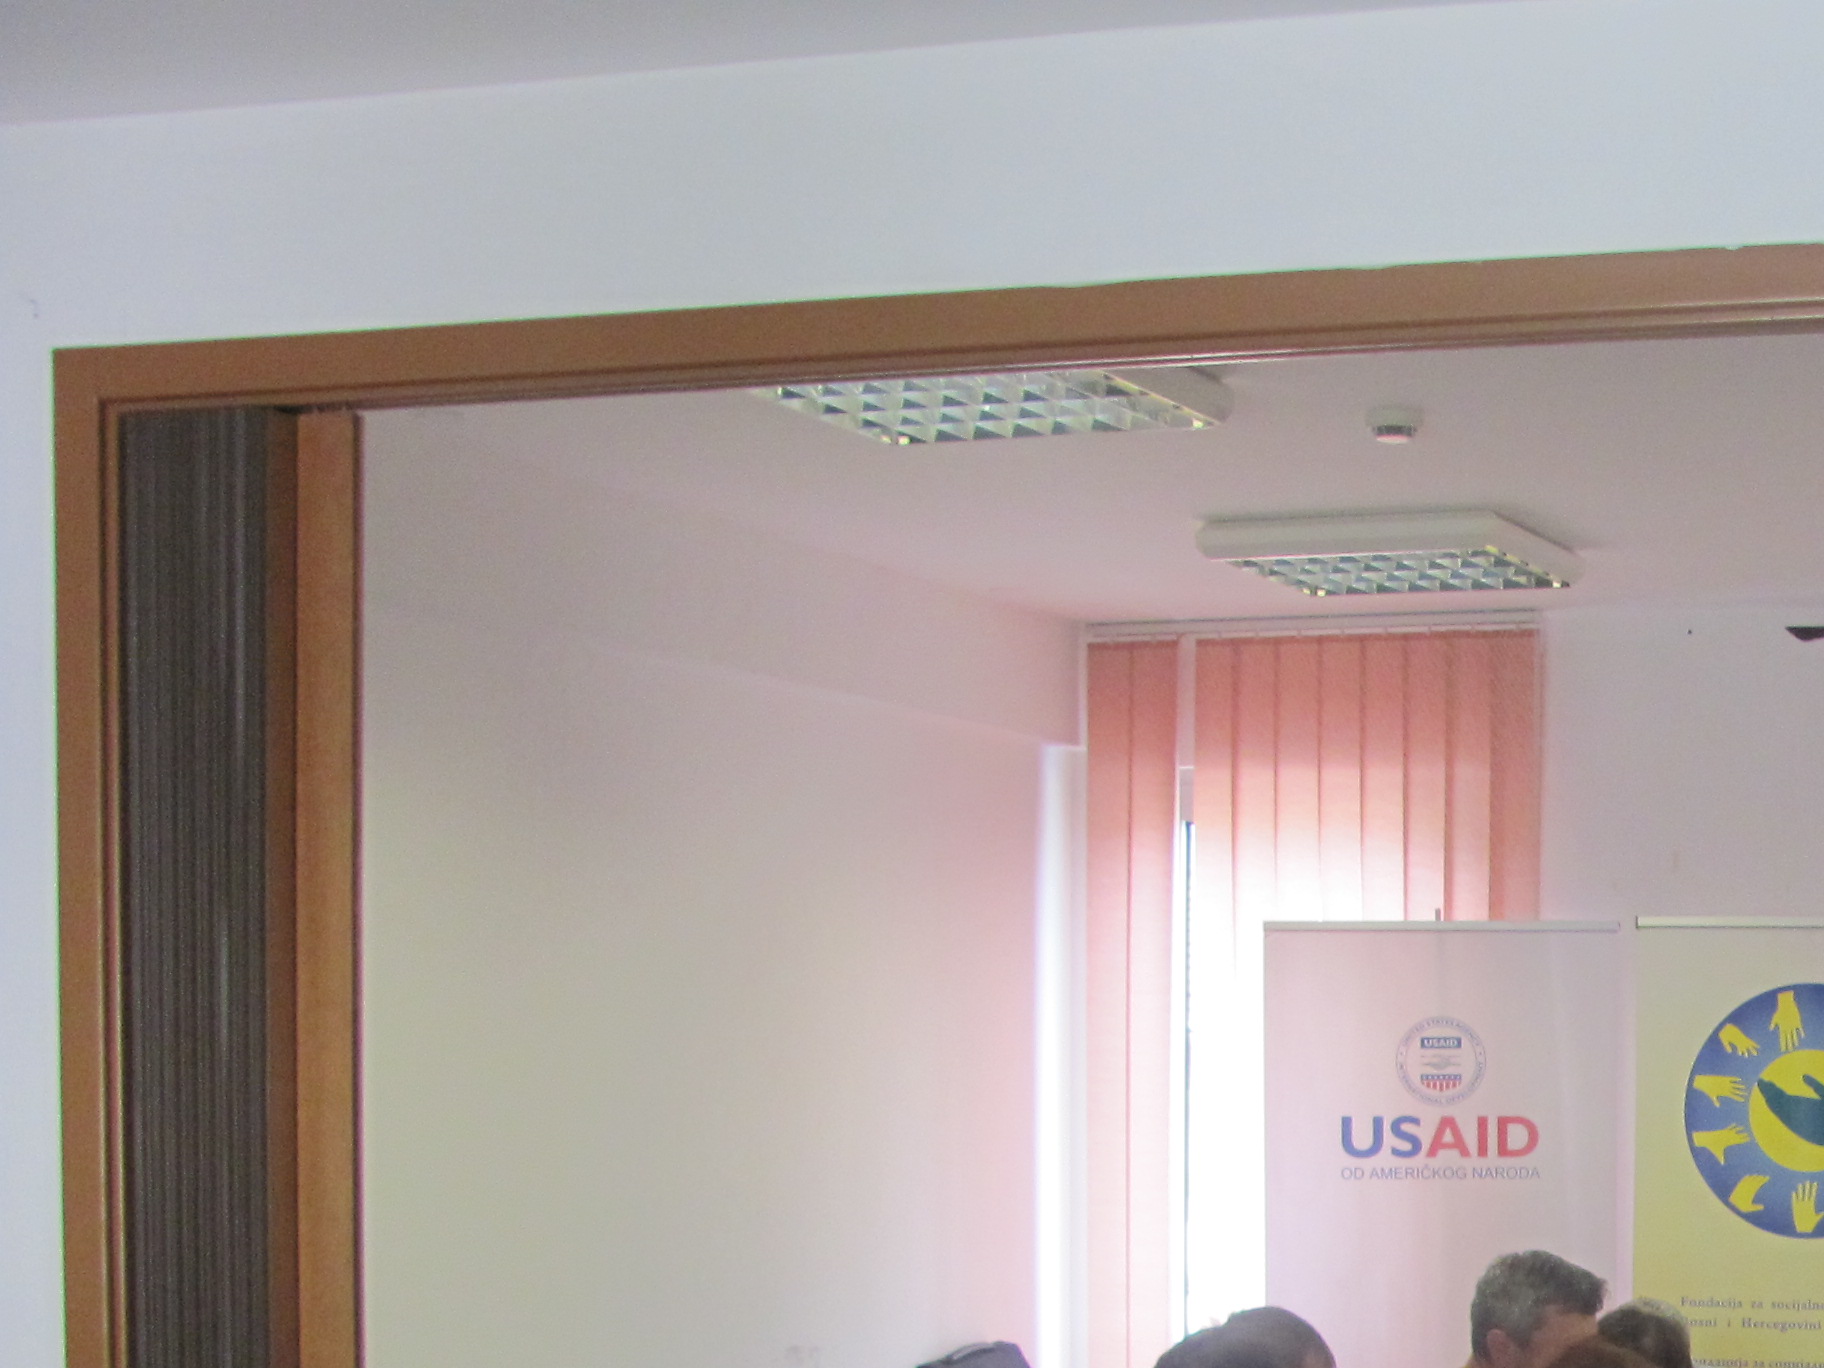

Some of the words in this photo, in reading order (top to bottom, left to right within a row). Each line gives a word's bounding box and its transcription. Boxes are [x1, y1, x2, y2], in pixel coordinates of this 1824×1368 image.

[1424, 1037, 1459, 1048] USAID
[1340, 1115, 1540, 1159] USAID
[1341, 1166, 1365, 1181] OD
[1369, 1164, 1467, 1181] AMERIČKOG
[1472, 1165, 1541, 1180] NARODA
[1680, 1296, 1743, 1311] Fondacija
[1751, 1301, 1764, 1310] za
[1742, 1317, 1823, 1332] Hercegovini
